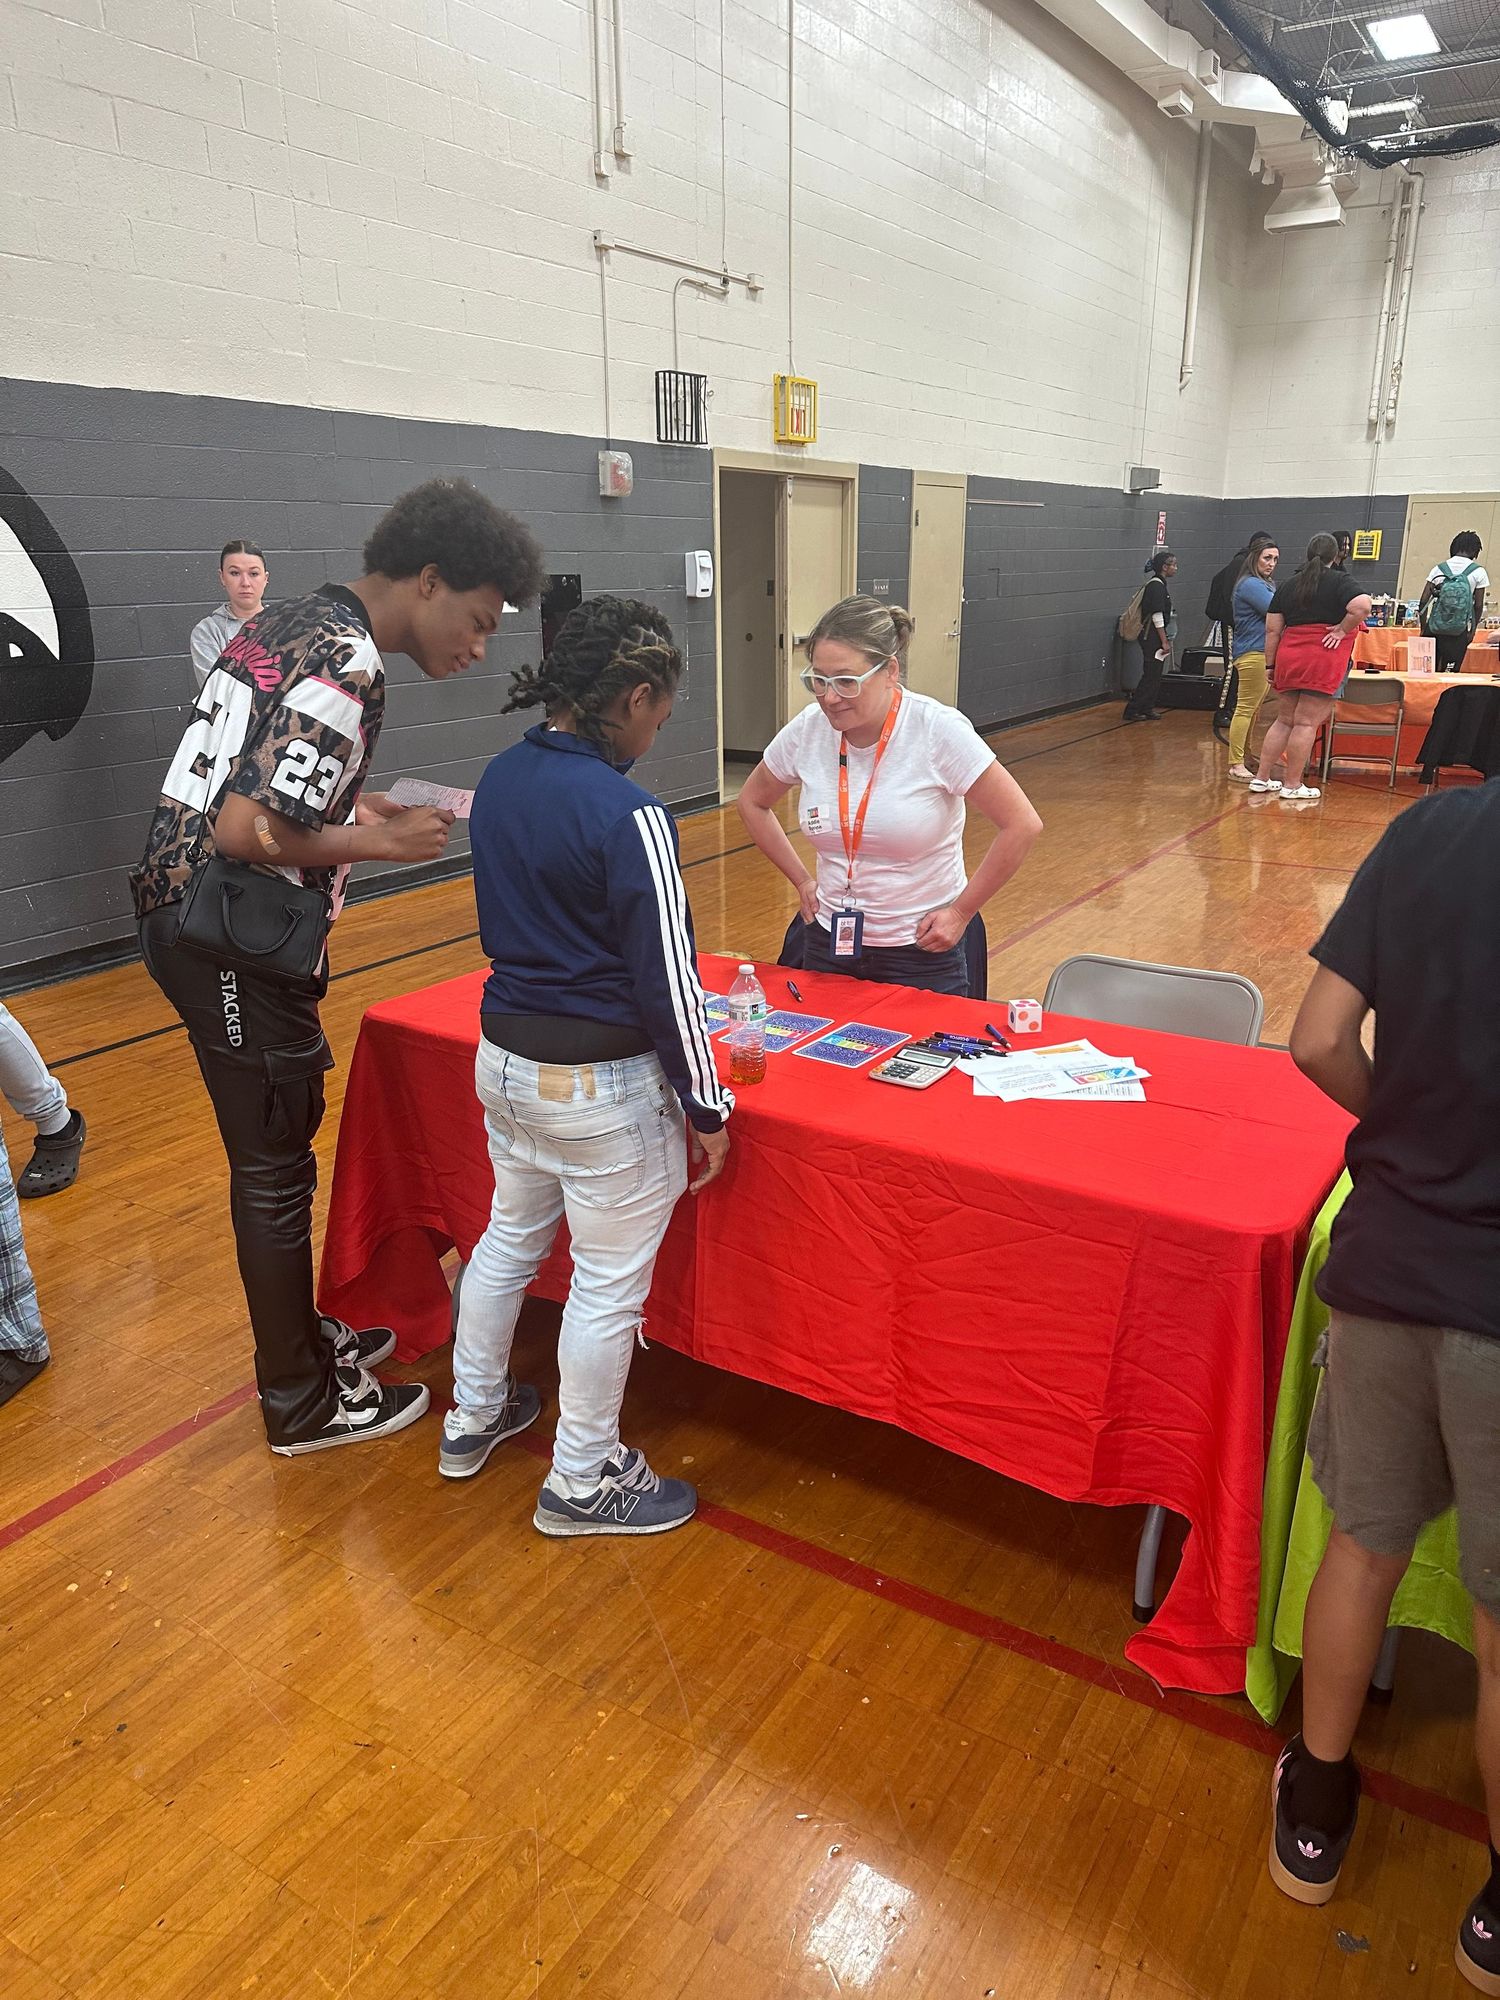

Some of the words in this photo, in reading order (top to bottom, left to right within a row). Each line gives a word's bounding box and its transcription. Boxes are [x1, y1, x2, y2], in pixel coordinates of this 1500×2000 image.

[269, 738, 344, 812] 23
[220, 970, 243, 1047] STACKED
[598, 1489, 641, 1523] N
